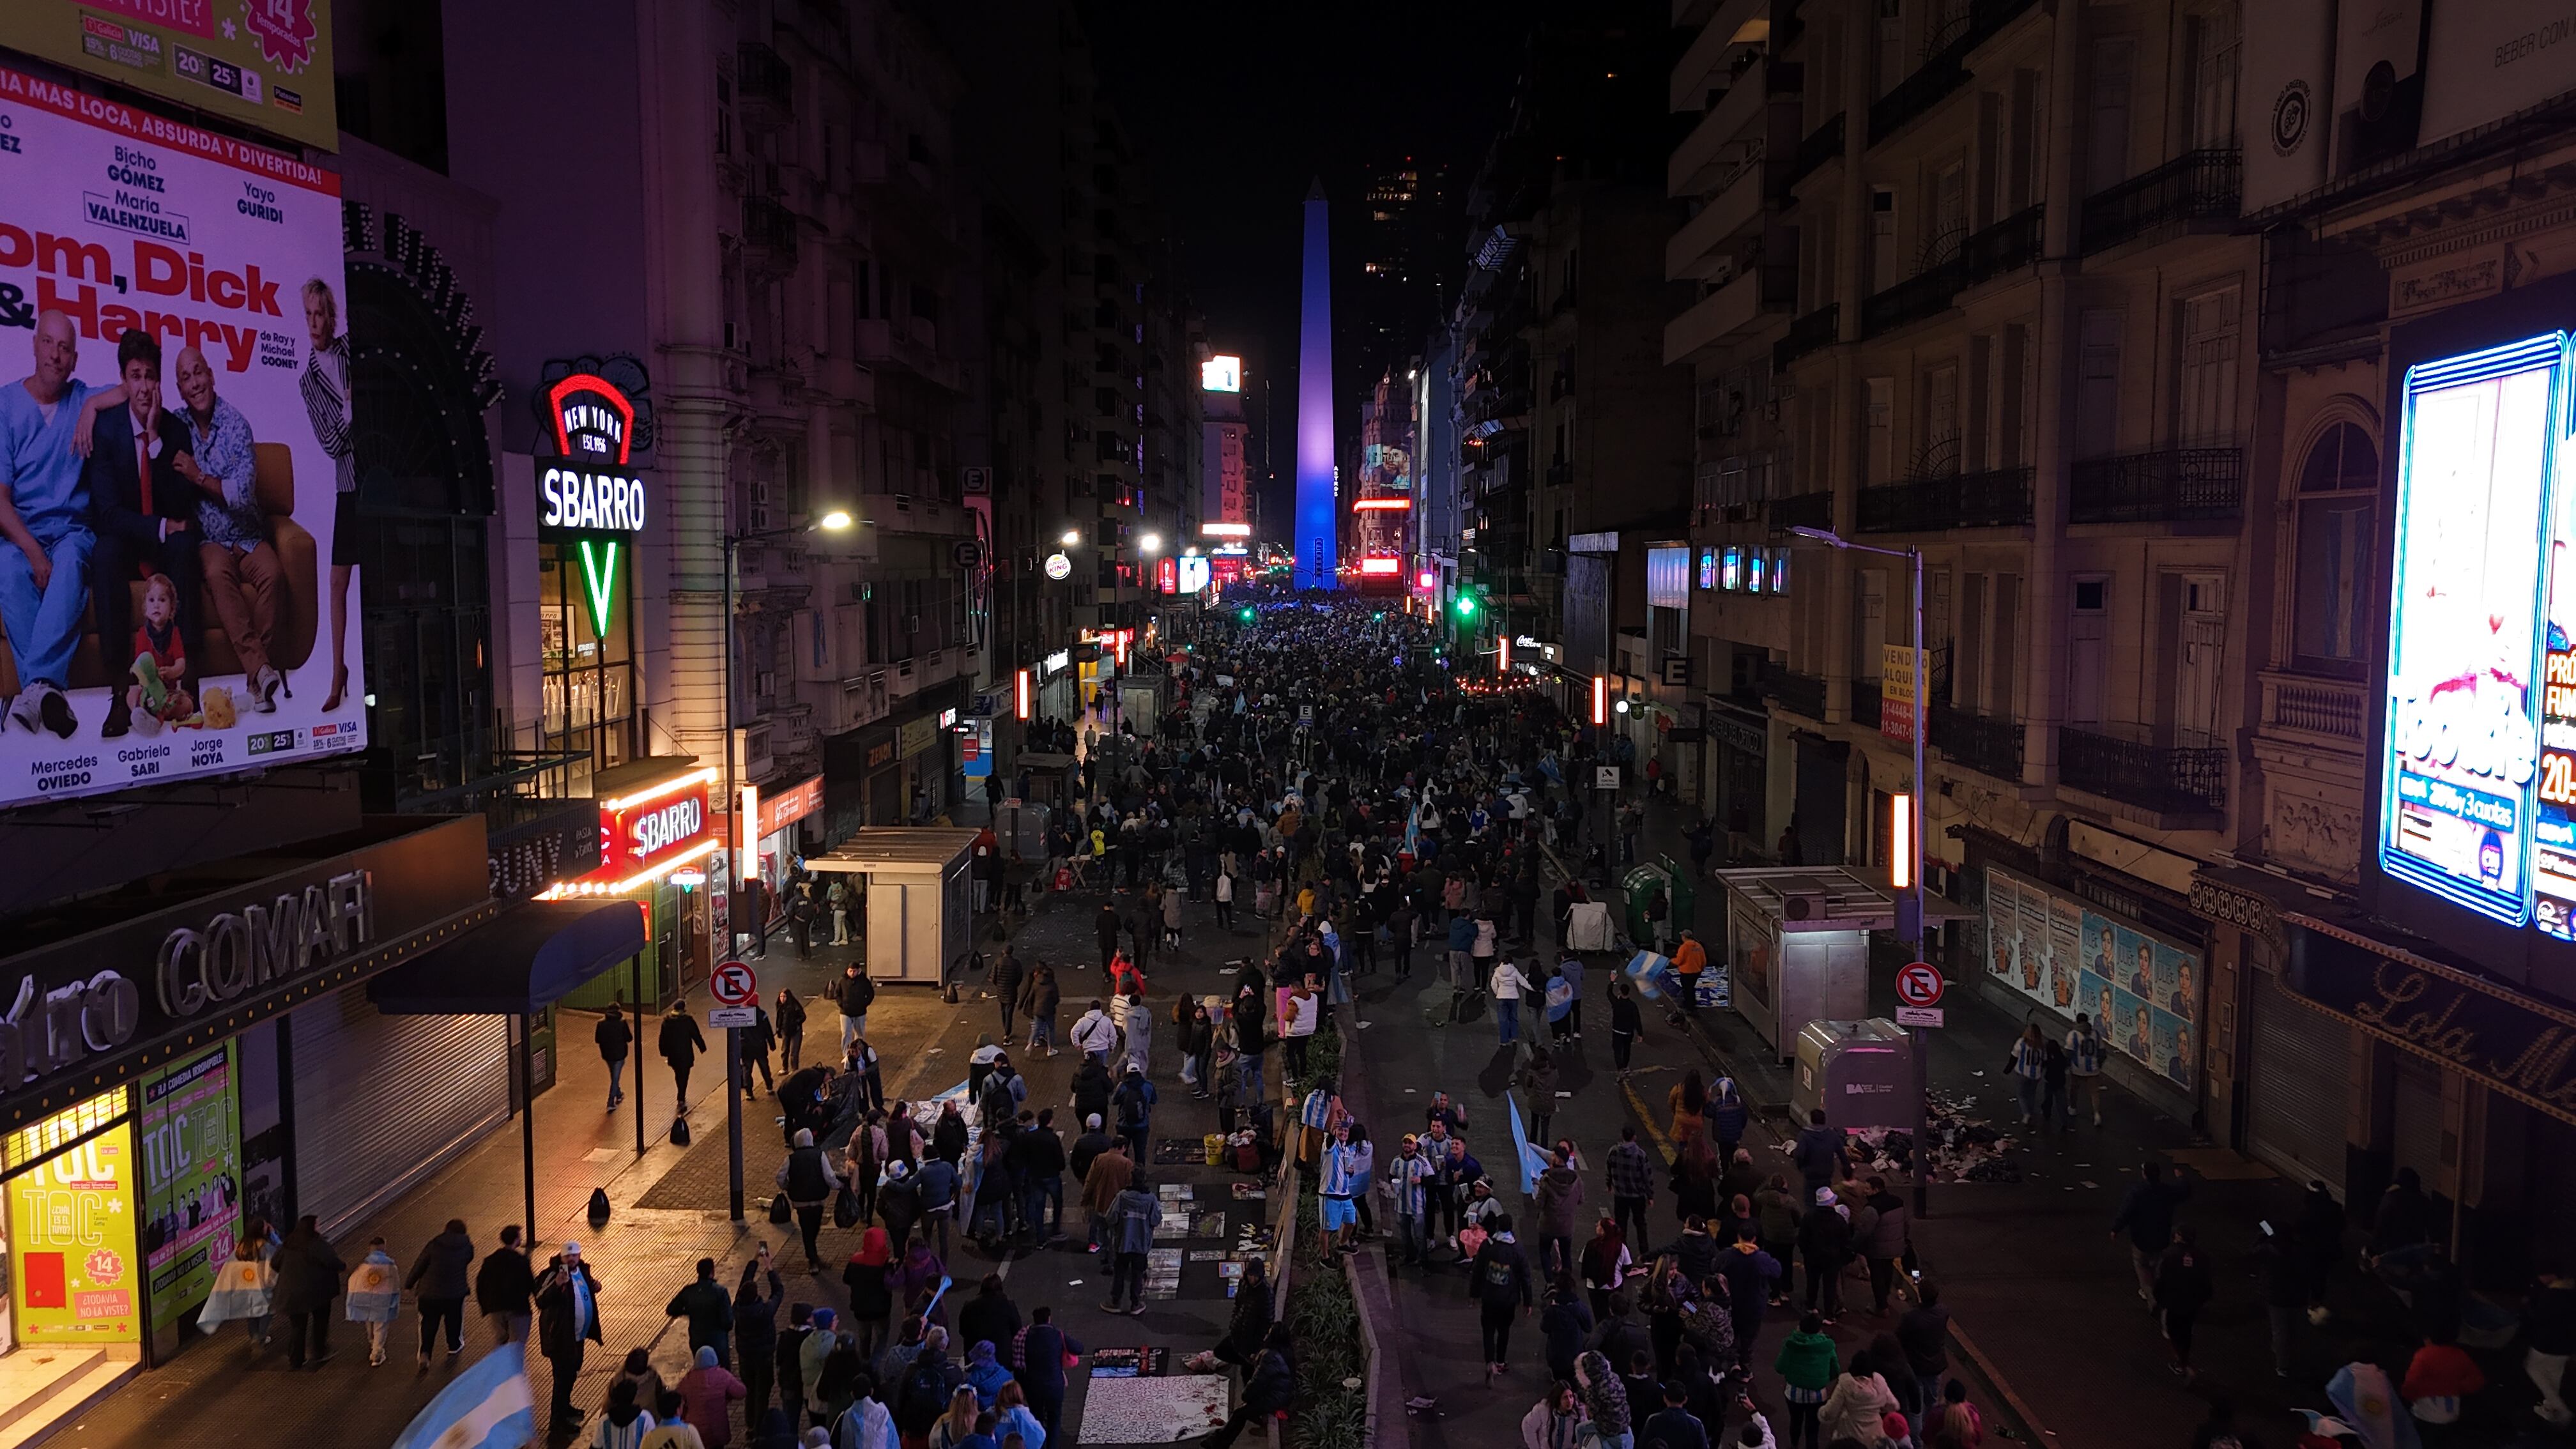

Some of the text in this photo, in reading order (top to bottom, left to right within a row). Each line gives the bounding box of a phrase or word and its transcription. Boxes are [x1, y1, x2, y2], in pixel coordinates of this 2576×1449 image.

[128, 29, 160, 53] VISA
[256, 12, 302, 48] Temporadas
[109, 43, 118, 61] 6
[2495, 33, 2535, 68] BEBER
[2540, 17, 2570, 49] CON
[1, 70, 322, 185] IA MÁS LOCA, ABSURDA Y DIVERTIDA!
[0, 132, 22, 154] EZ
[114, 145, 156, 171] Bicho
[107, 164, 165, 193] GÓMEZ
[115, 189, 160, 215] María
[243, 181, 275, 204] Yayo
[88, 201, 187, 240] VALENZUELA
[236, 199, 284, 224] GURIDI
[134, 240, 283, 318] Dick
[0, 276, 257, 373] & Harry
[260, 330, 272, 341] de
[273, 332, 289, 346] Ray
[261, 343, 295, 357] Michael
[261, 355, 298, 369] COONEY
[565, 405, 622, 443] NEW YORK
[544, 468, 645, 532] SBARRO
[1049, 563, 1068, 574] KING
[1885, 648, 1917, 667] VEND
[1666, 660, 1687, 684] E
[1883, 668, 1926, 687] ALQUIA
[1889, 686, 1897, 695] EN
[339, 721, 357, 733] VISA
[118, 744, 171, 763] Gabriela
[191, 738, 224, 755] Jorge
[31, 754, 98, 777] Mercedes
[130, 762, 160, 778] SARI
[192, 751, 224, 768] NOYA
[37, 772, 91, 792] OVIEDO
[2465, 792, 2474, 816] 3
[2474, 801, 2513, 827] cuotas
[637, 797, 700, 857] SBARRO
[155, 868, 374, 1018] COMAFI
[2352, 960, 2475, 1064] Lola
[2027, 1048, 2040, 1066] 10
[2081, 1038, 2095, 1057] 10
[168, 1068, 192, 1090] COMEDIA
[22, 1114, 115, 1187] TOC
[143, 1113, 191, 1188] TOC
[192, 1096, 234, 1164] TOC
[22, 1189, 103, 1246] TOC
[52, 1204, 71, 1215] ¿CUÁL
[54, 1215, 68, 1224] ES EL
[52, 1225, 71, 1234] TUYO?
[215, 1236, 230, 1259] 14
[95, 1255, 112, 1273] 14
[82, 1291, 118, 1305] ¿TODAVÍA
[583, 1292, 588, 1301] 6
[80, 1304, 128, 1318] NO LA VISTE?
